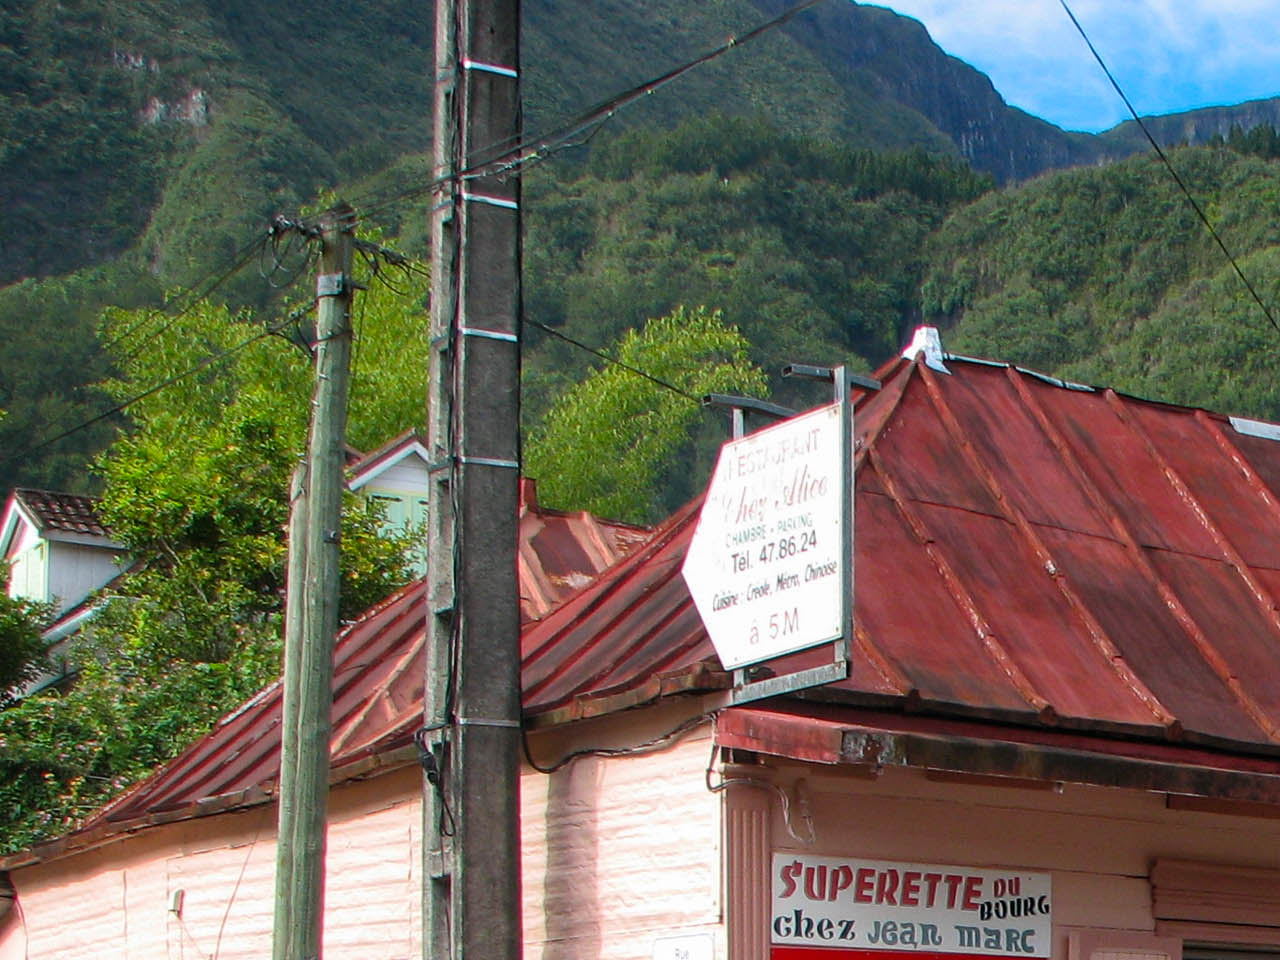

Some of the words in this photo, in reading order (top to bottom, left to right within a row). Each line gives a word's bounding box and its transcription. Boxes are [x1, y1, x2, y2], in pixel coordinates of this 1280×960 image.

[726, 525, 766, 548] CHAMBRE
[777, 512, 813, 532] PARKING
[759, 529, 817, 564] 47.86.24
[778, 861, 984, 910] SUPERETTE
[993, 876, 1021, 898] DU
[774, 909, 856, 941] chez
[979, 895, 1050, 922] BOURG
